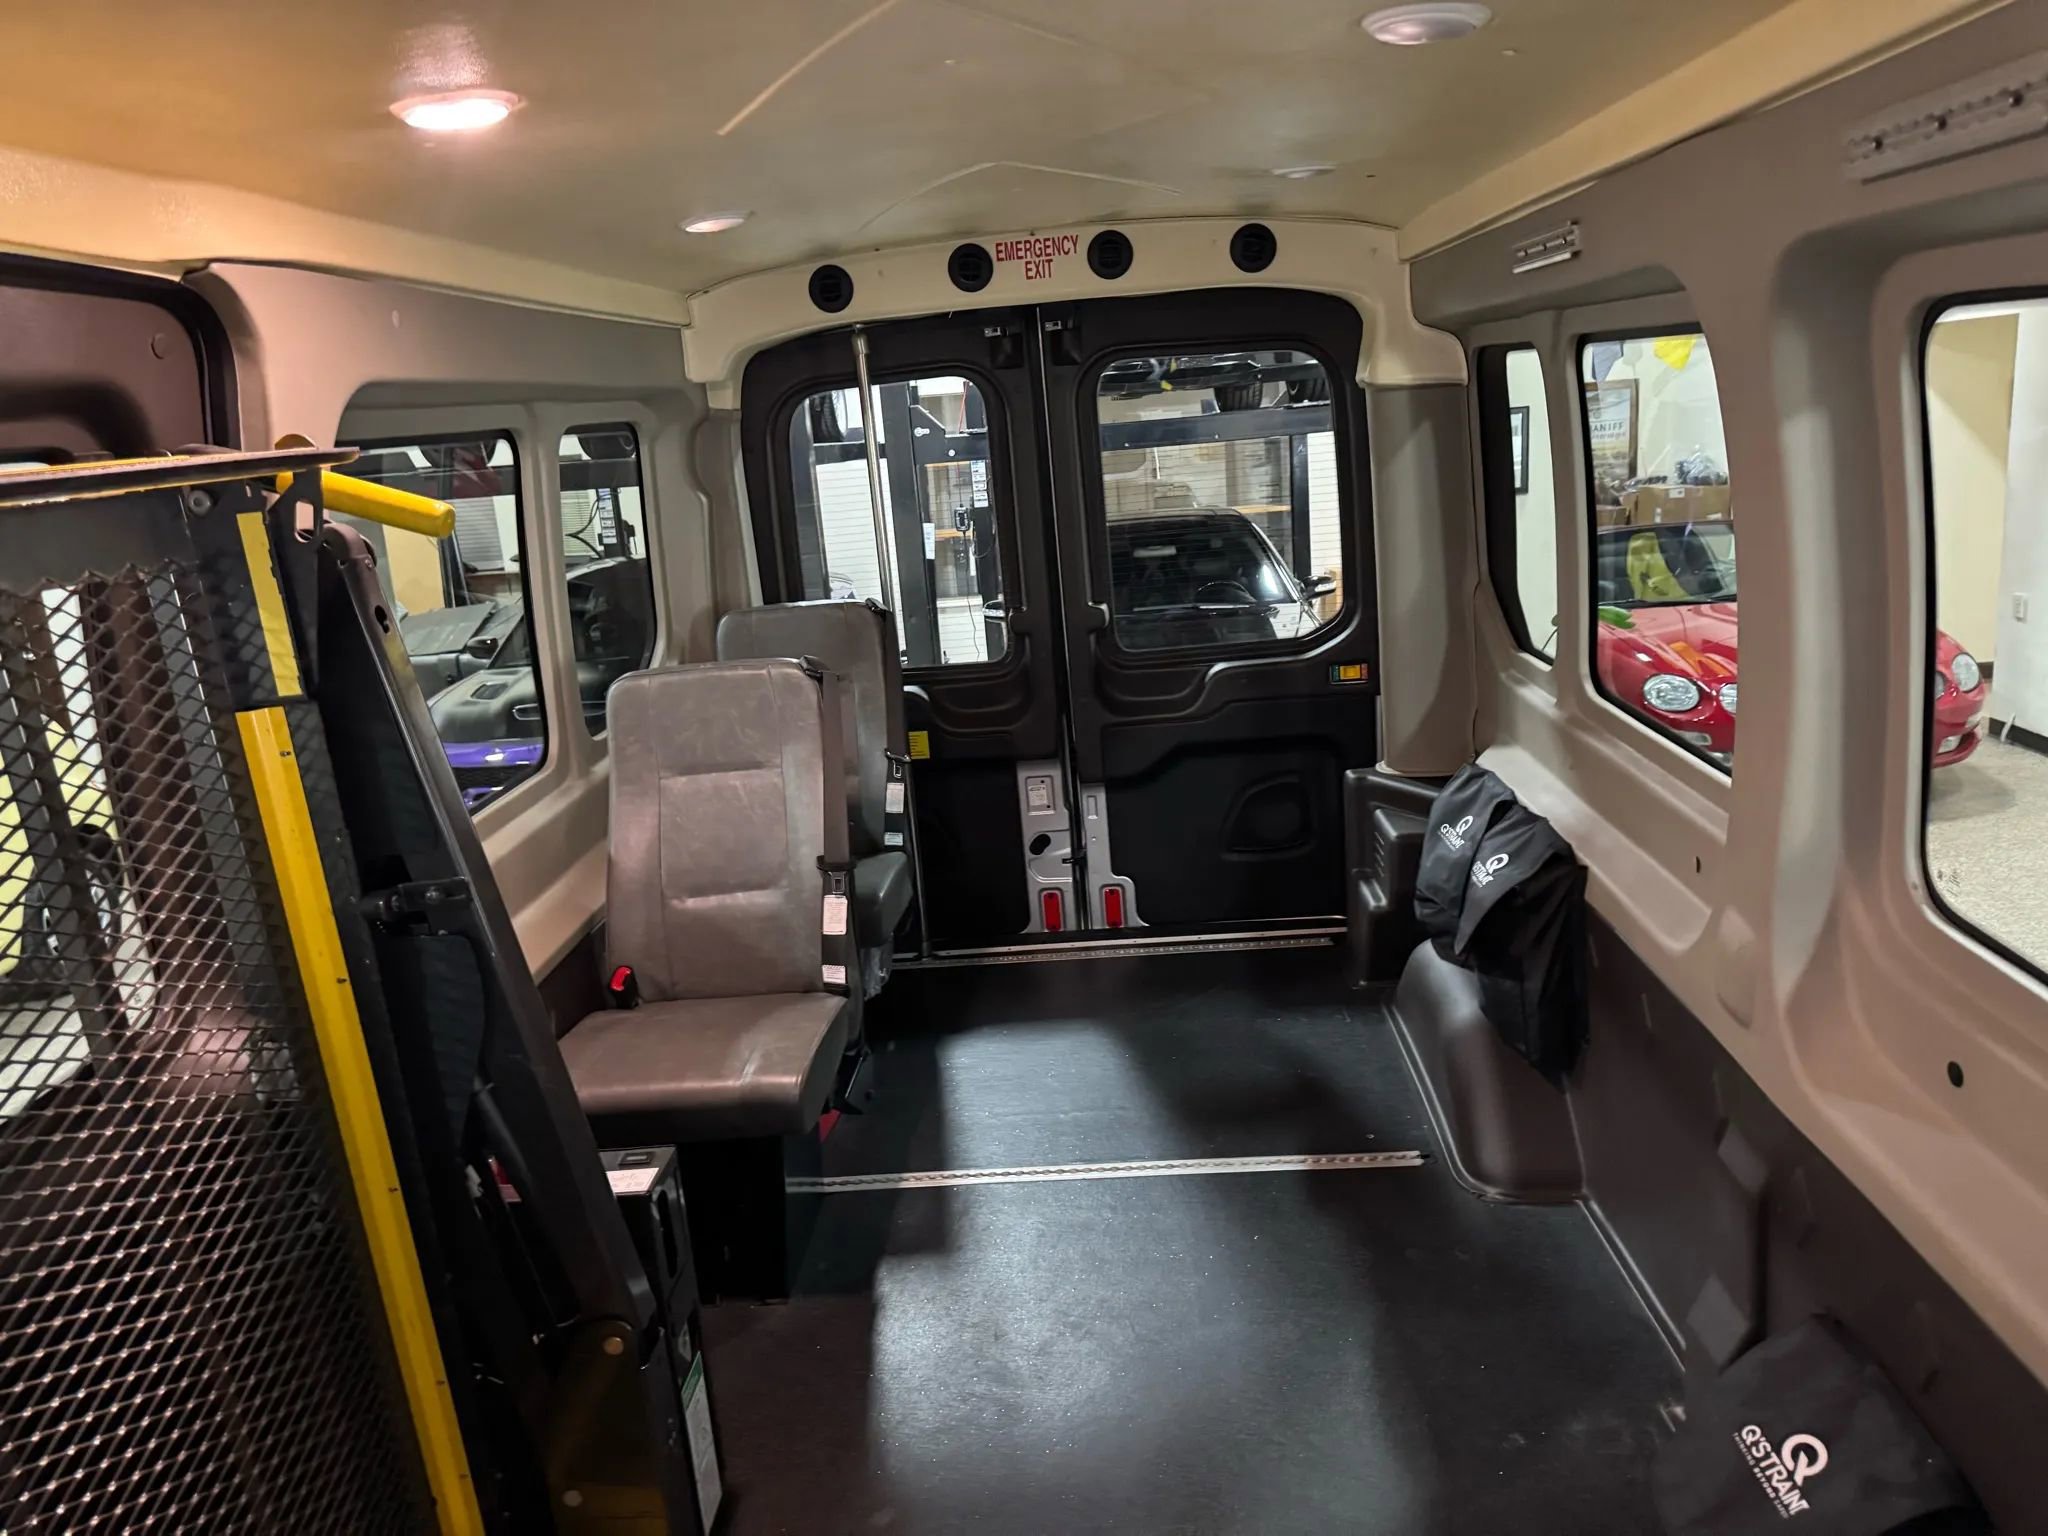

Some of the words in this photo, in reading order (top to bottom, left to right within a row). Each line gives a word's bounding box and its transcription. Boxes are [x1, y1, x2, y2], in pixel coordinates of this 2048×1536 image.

[995, 234, 1079, 261] EMERGENCY
[1025, 259, 1054, 280] EXIT
[1590, 422, 1625, 431] ANIFF
